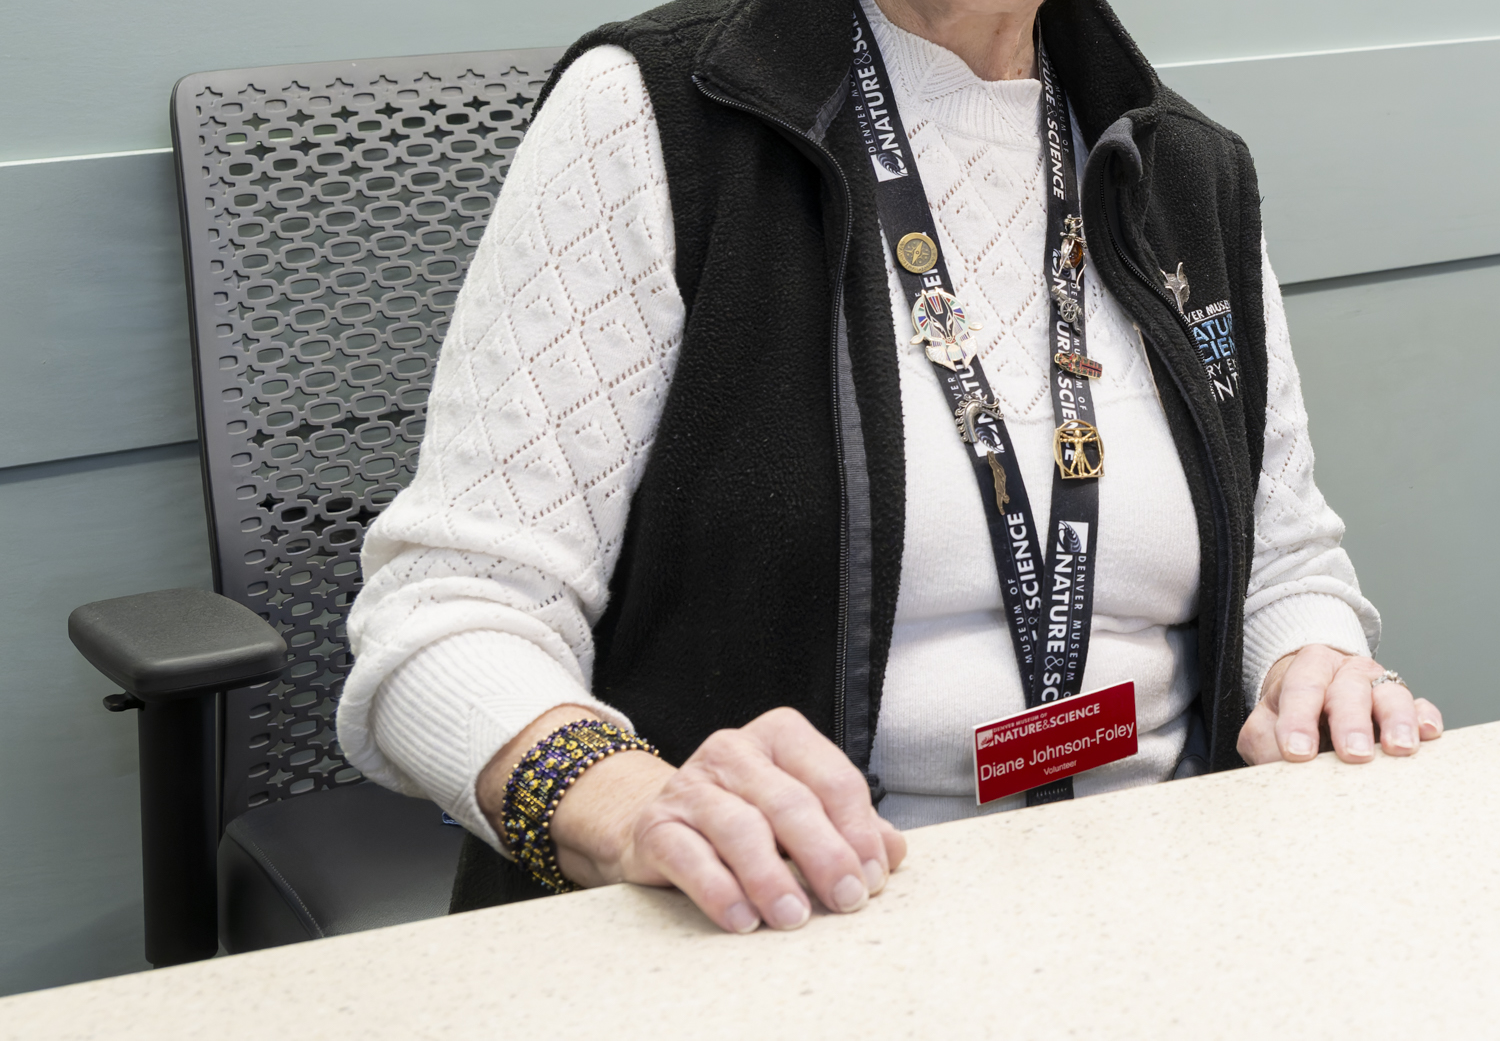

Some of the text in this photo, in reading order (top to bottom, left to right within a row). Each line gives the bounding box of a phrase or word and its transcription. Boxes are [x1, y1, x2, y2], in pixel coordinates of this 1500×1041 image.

[855, 105, 877, 154] DENVER
[1074, 555, 1087, 610] DENVER
[1066, 619, 1082, 681] MUSEUM
[993, 722, 1015, 733] DENVER
[1015, 715, 1039, 726] MUSEUM
[980, 722, 1135, 781] Diane Johnson-Foley
[1043, 760, 1077, 776] Volunteer
